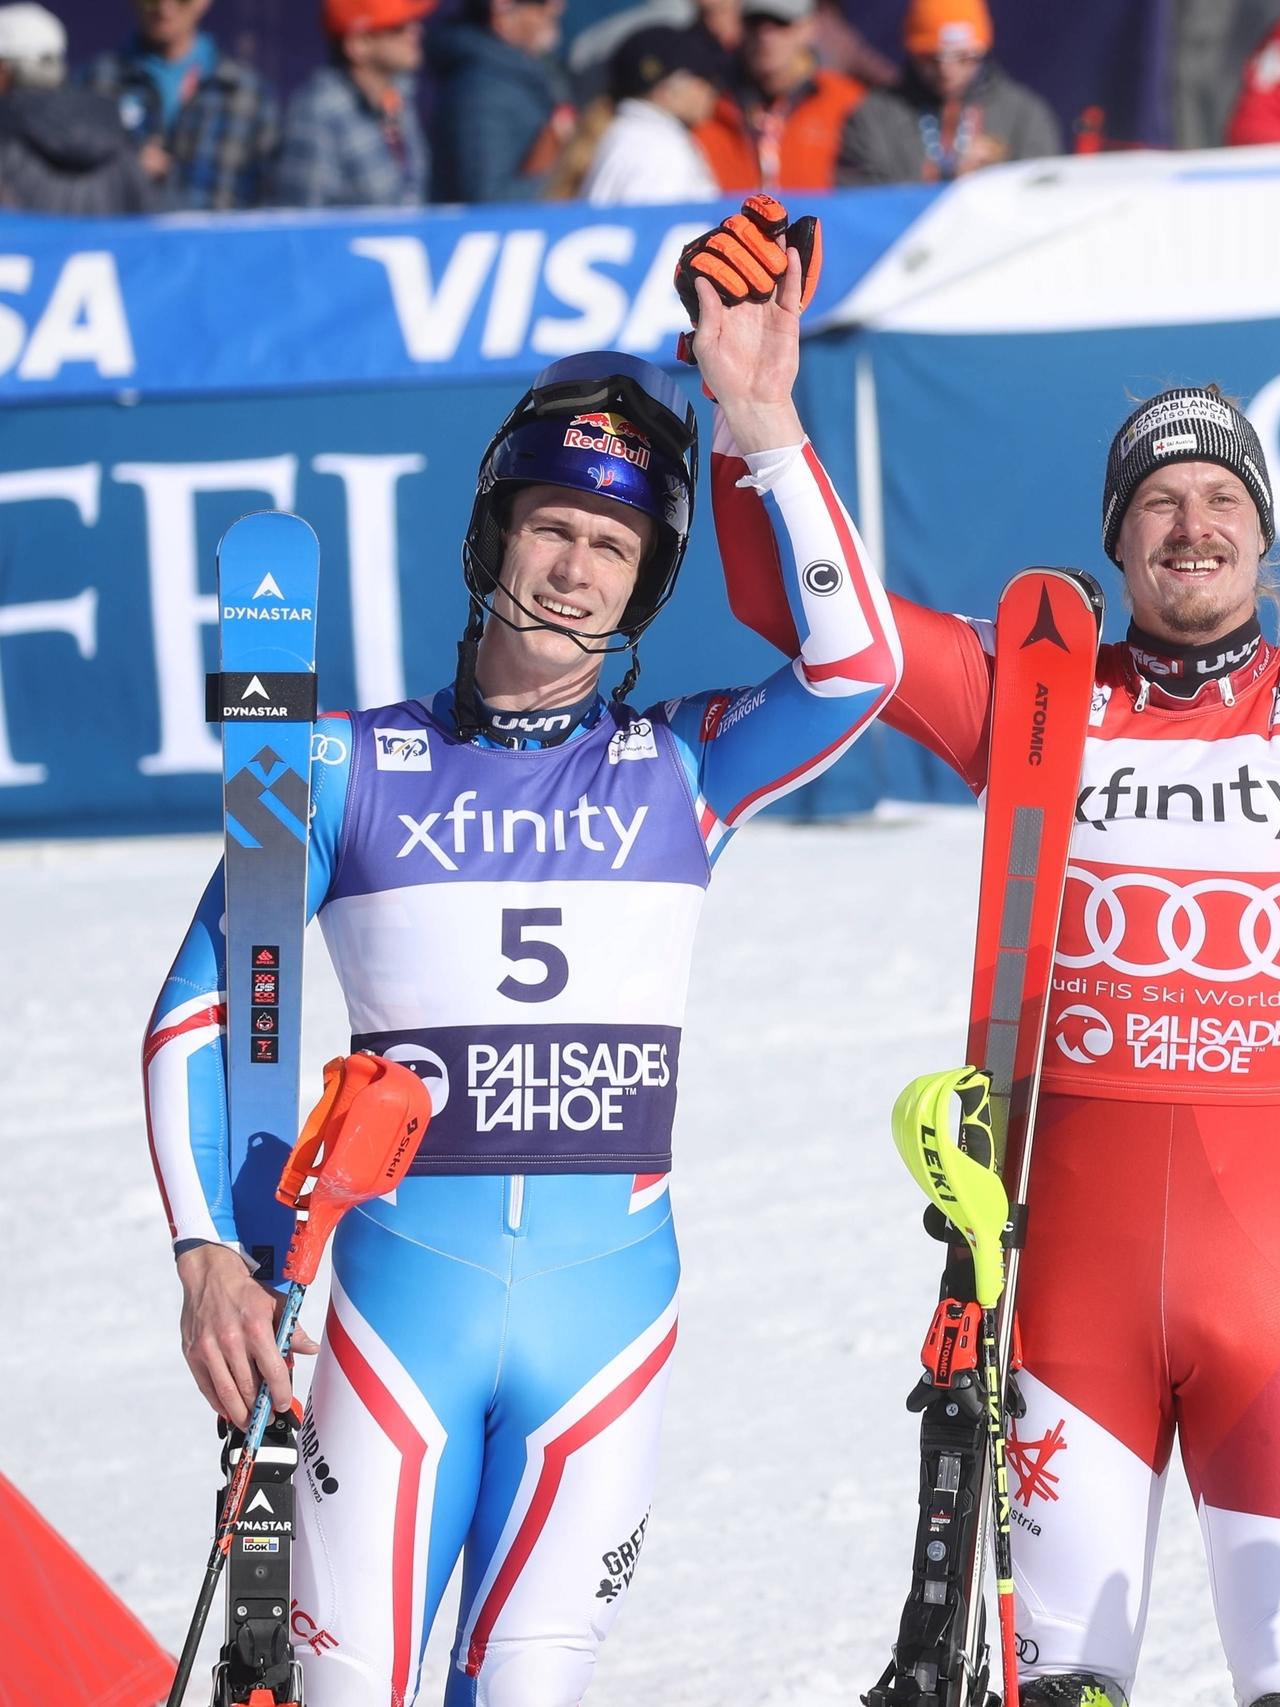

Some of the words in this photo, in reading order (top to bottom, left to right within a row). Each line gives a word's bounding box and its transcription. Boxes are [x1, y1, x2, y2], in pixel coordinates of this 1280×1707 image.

[1136, 400, 1228, 429] CASABLANCA
[1136, 408, 1230, 437] hotelsoftware
[563, 428, 610, 453] Red
[609, 436, 651, 471] Bull
[223, 606, 312, 621] DYNASTAR
[223, 706, 288, 717] DYNASTAR
[1028, 682, 1049, 767] ATOMIC
[396, 790, 649, 871] xfinity
[496, 908, 570, 1003] 5
[1052, 976, 1087, 995] udi
[1095, 980, 1133, 1000] FIS
[1143, 984, 1185, 1004] Ski
[468, 1042, 670, 1088] PALISADES
[1126, 1040, 1252, 1074] TAHOE
[468, 1086, 625, 1132] TAHOE
[920, 1124, 958, 1203] LEKI
[939, 1336, 953, 1378] ATOMIC
[236, 1521, 292, 1532] YNASTAR
[244, 1543, 268, 1551] LOOK
